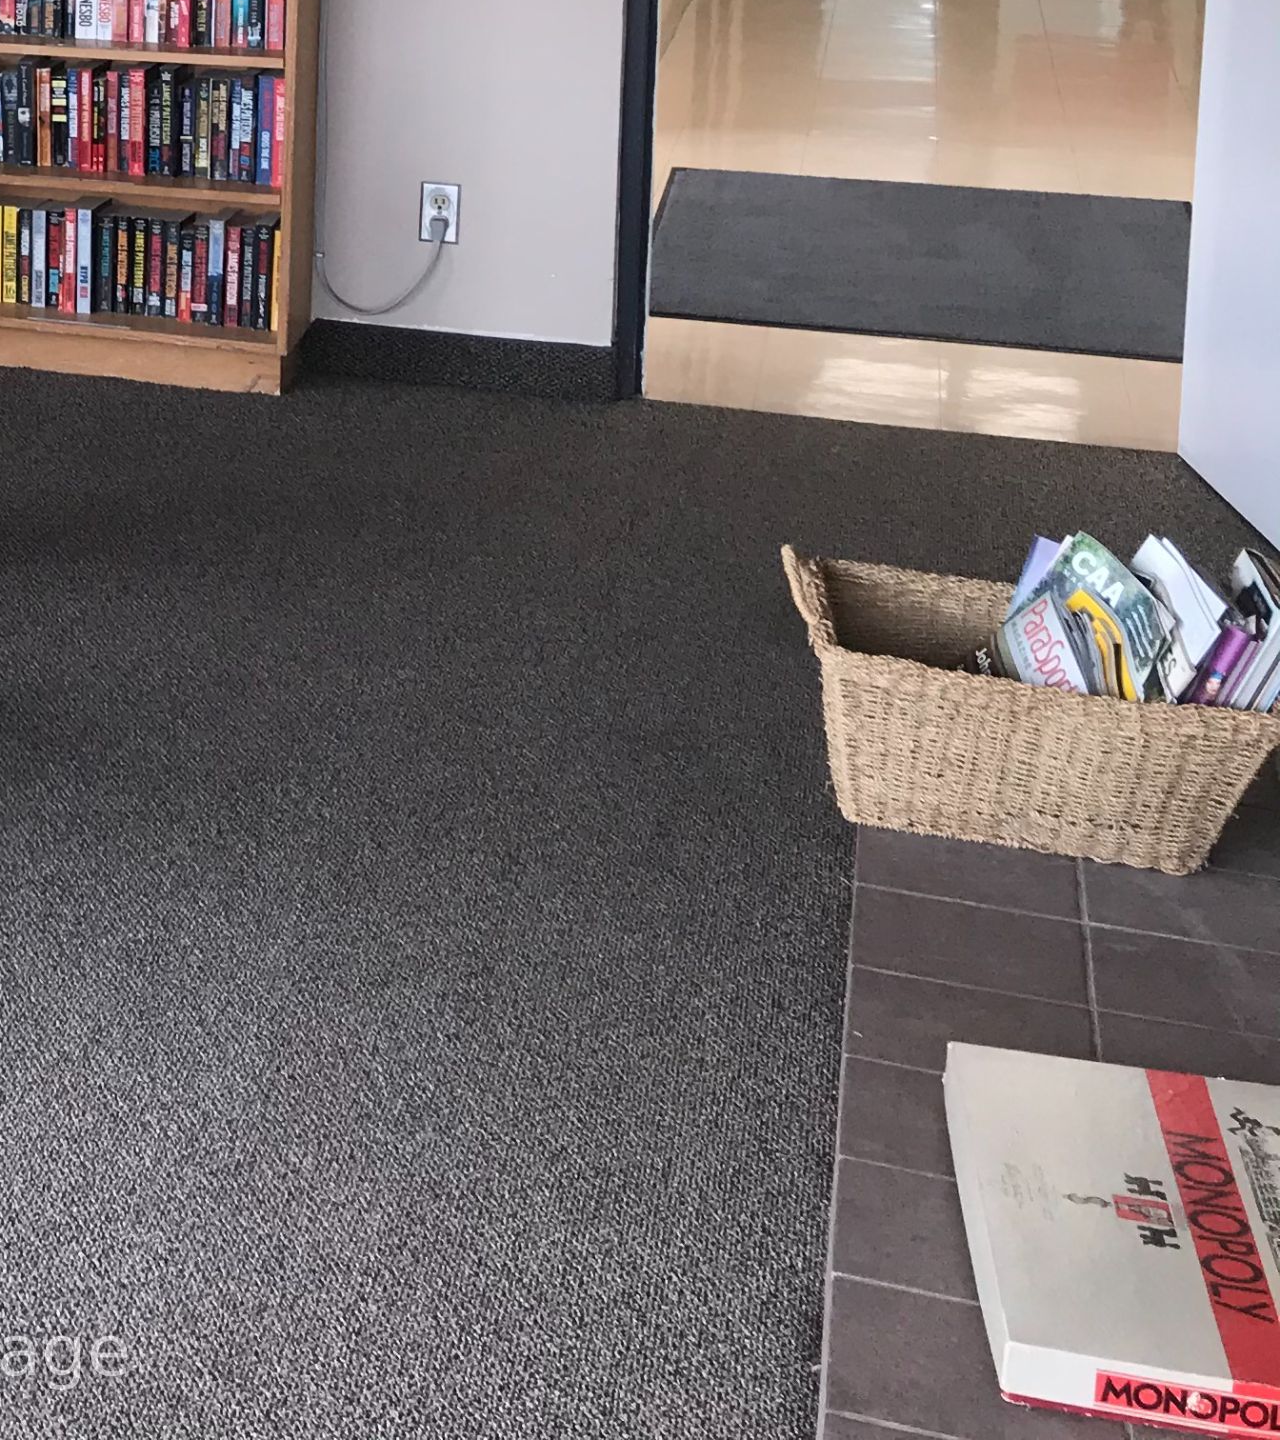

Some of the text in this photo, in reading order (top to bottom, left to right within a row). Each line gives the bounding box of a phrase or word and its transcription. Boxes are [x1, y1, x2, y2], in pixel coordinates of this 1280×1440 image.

[162, 83, 171, 145] JAMES PATTERSON
[134, 231, 144, 288] JAMES PATTERSON
[1071, 550, 1125, 609] CAA
[1166, 1130, 1275, 1324] MONOPOLY
